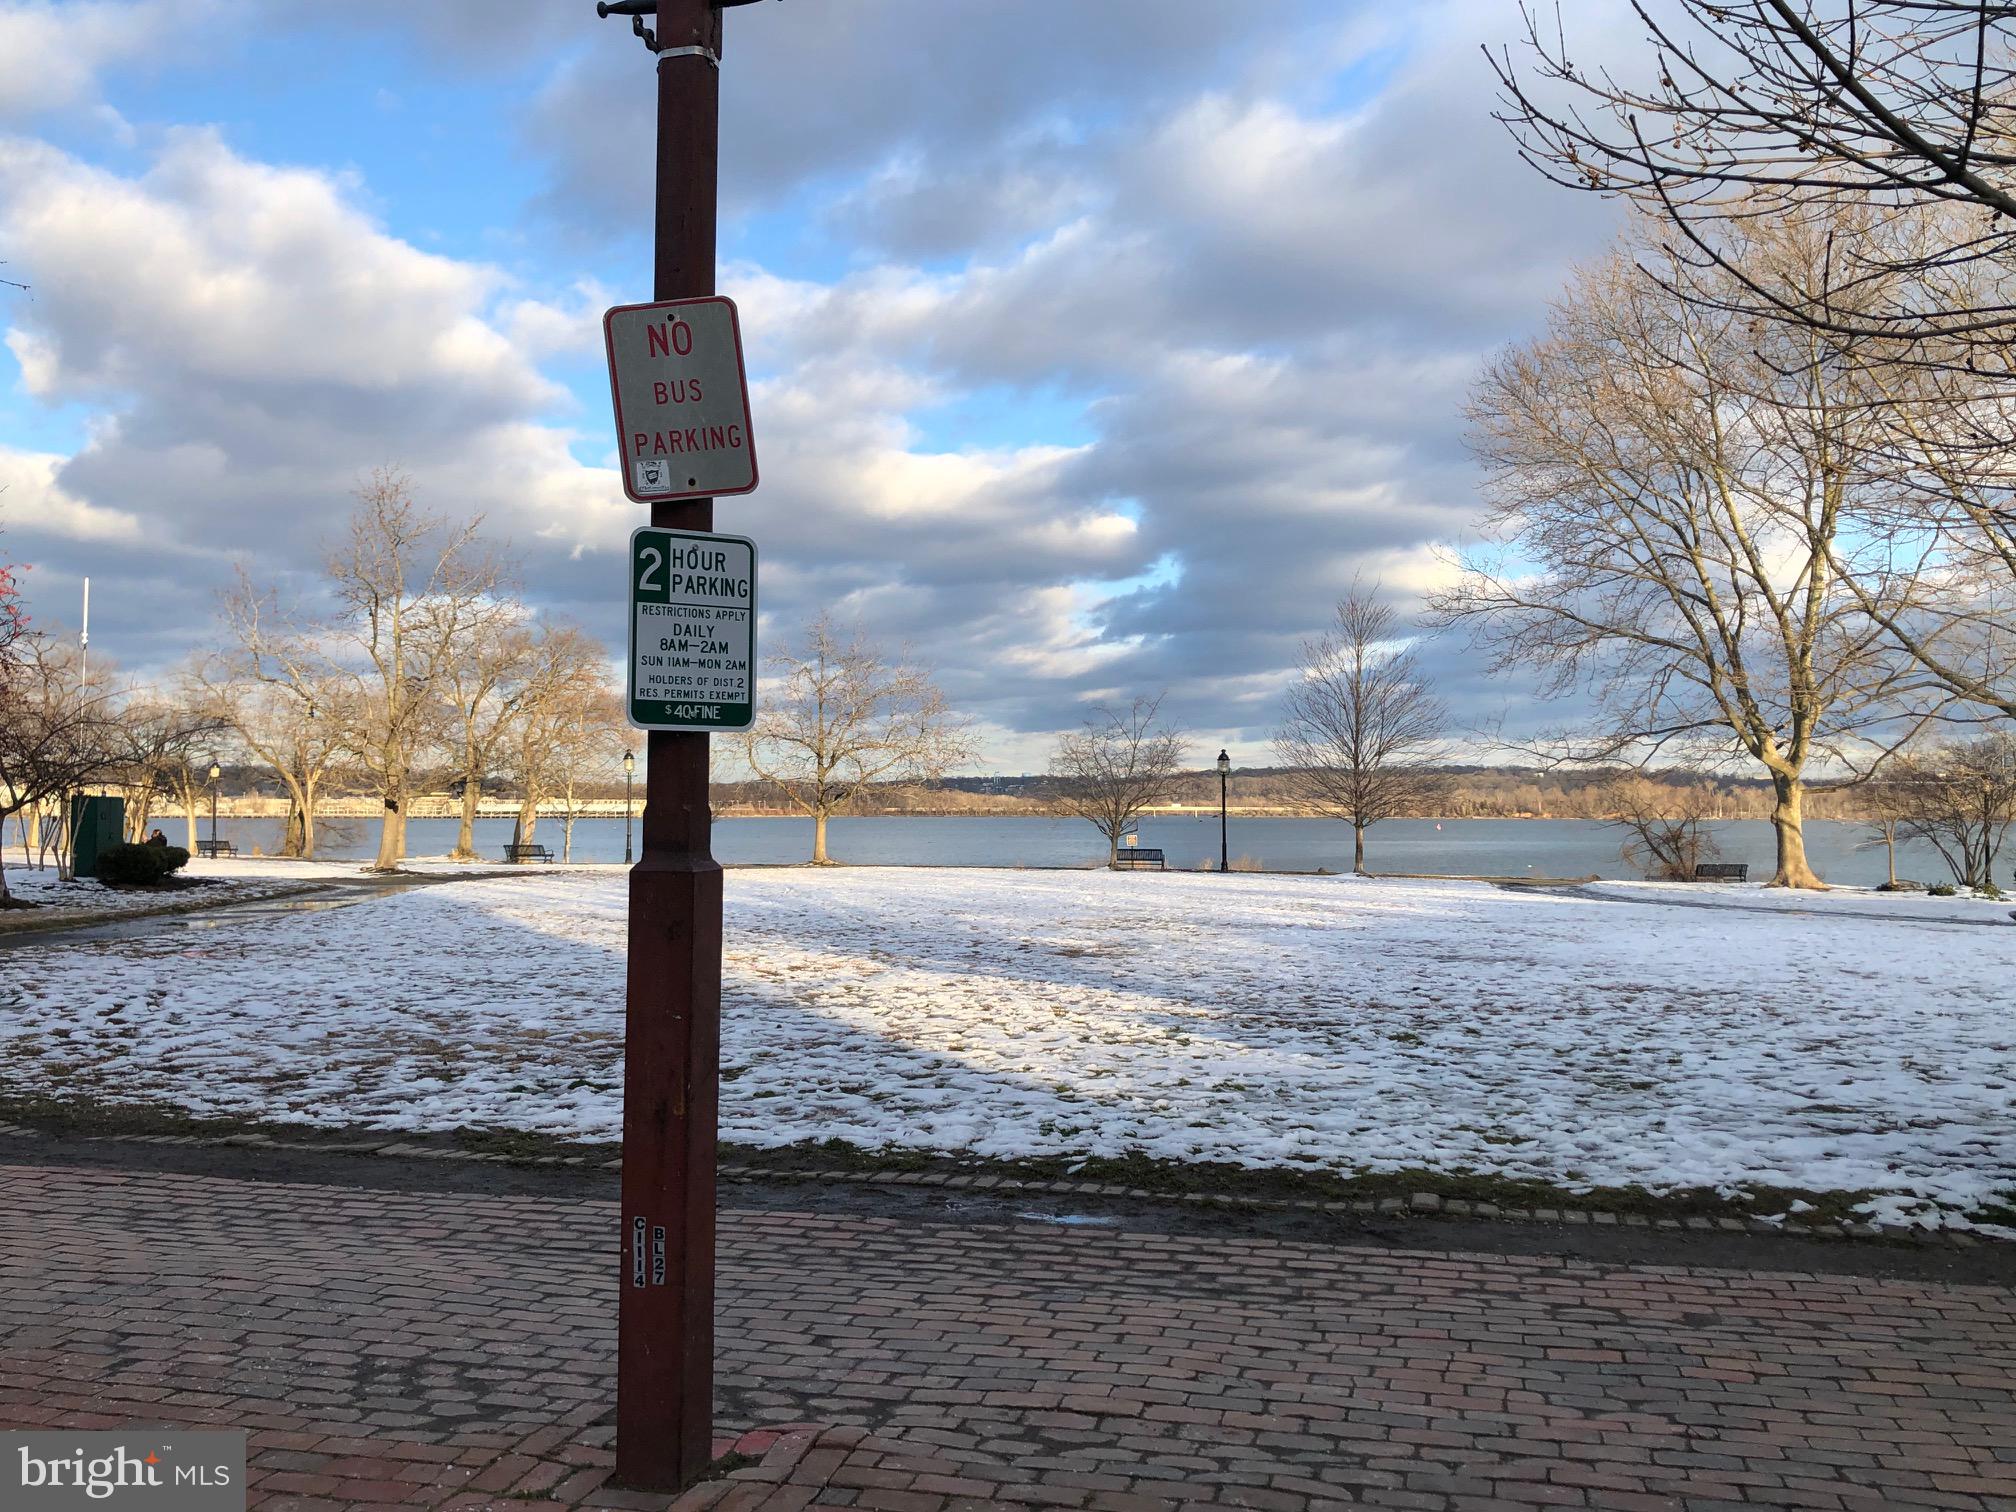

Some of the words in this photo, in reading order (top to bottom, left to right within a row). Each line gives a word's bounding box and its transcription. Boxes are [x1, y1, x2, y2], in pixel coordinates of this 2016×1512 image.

[647, 321, 693, 358] NO
[653, 378, 703, 405] BUS
[634, 425, 741, 456] PARKING
[639, 547, 662, 591] 2
[672, 548, 726, 572] HOUR
[672, 574, 748, 598] PARKING
[642, 605, 711, 619] RESTRICTIONS
[715, 610, 746, 622] APPLY
[673, 623, 715, 638] DAILY
[641, 655, 663, 667] SUN
[725, 660, 746, 671] 2AM
[648, 675, 693, 686] HOLDERS
[697, 677, 709, 686] OF
[664, 689, 705, 699] PERMITS
[709, 691, 746, 701] EXEMPT
[694, 705, 721, 720] FINE
